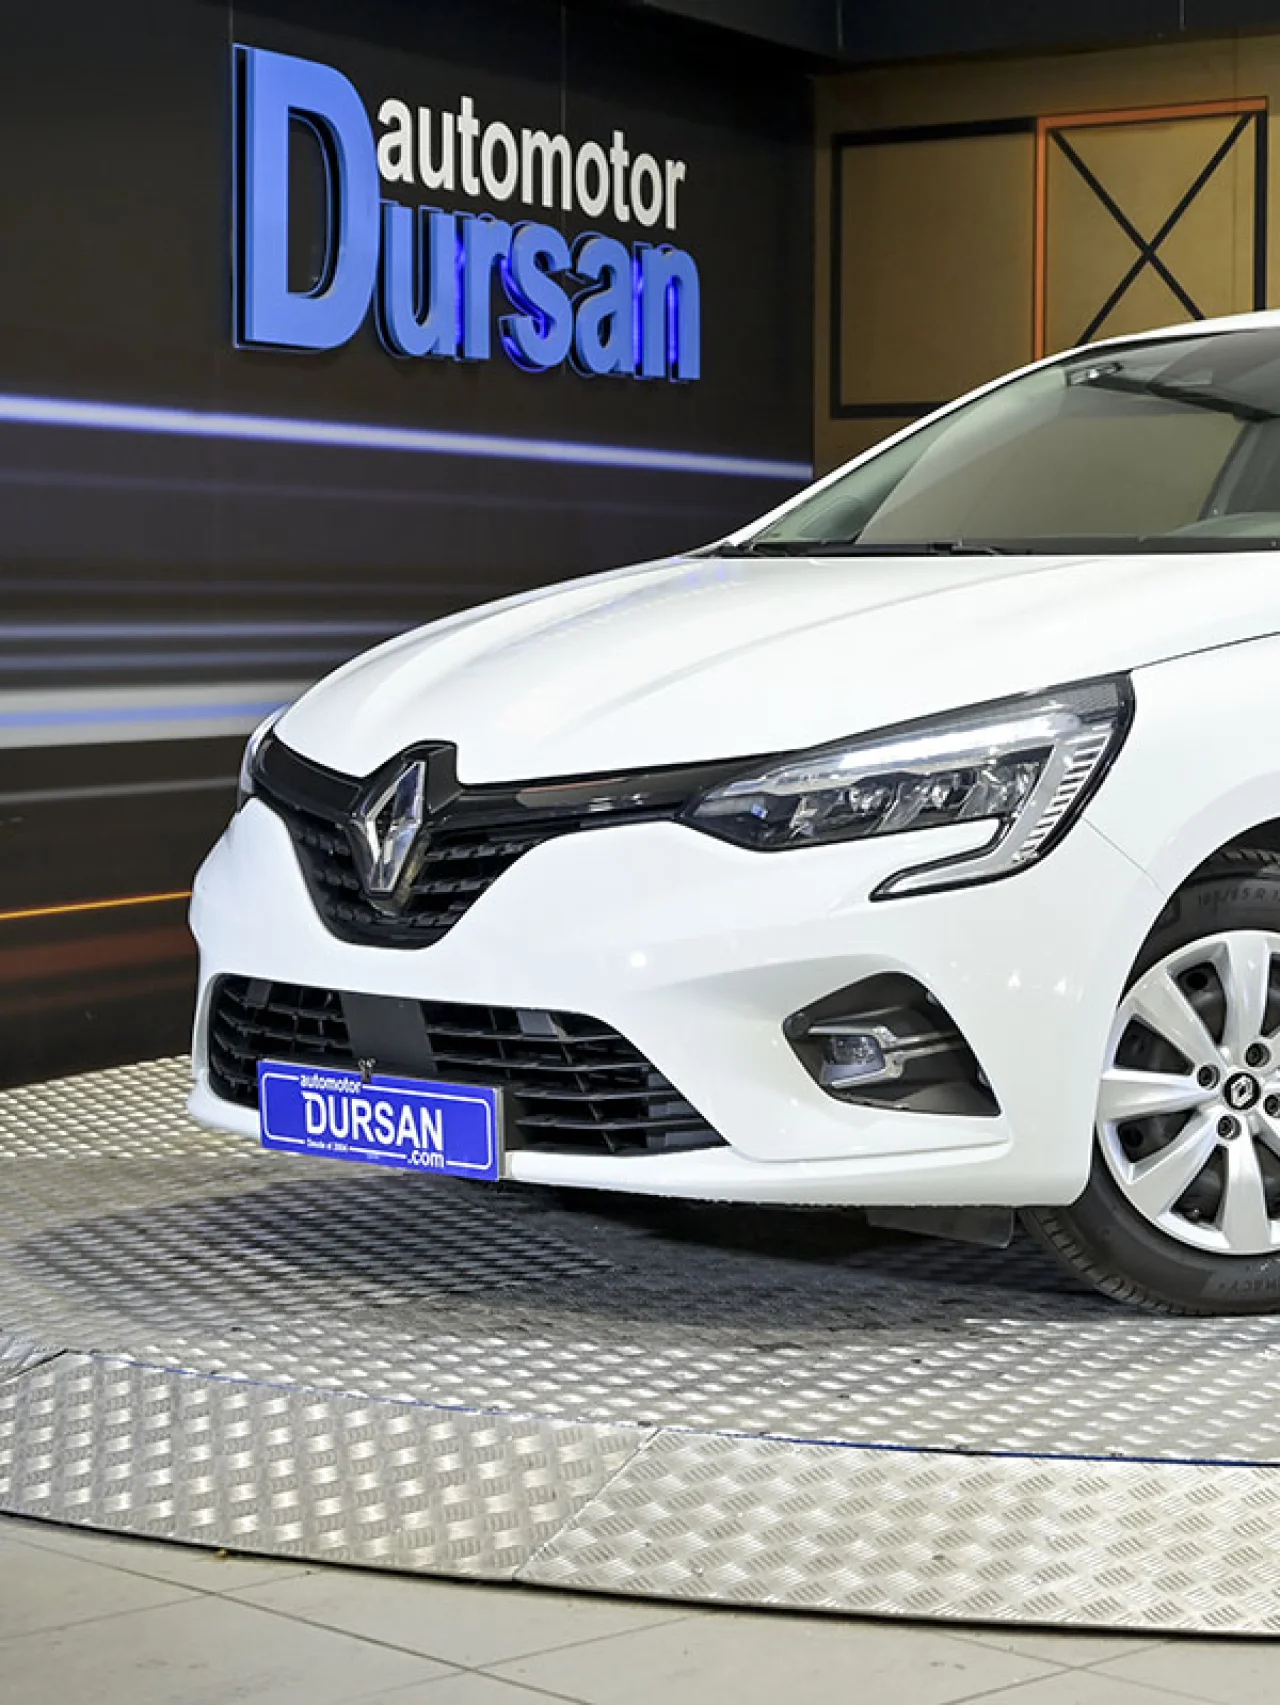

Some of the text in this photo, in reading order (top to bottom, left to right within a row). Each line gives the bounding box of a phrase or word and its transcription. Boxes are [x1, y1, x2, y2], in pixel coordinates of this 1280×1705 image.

[377, 96, 686, 229] automotor
[233, 42, 700, 382] Dursan
[300, 1073, 362, 1094] automotor
[302, 1091, 444, 1151] DURSAN
[407, 1149, 444, 1168] .com
